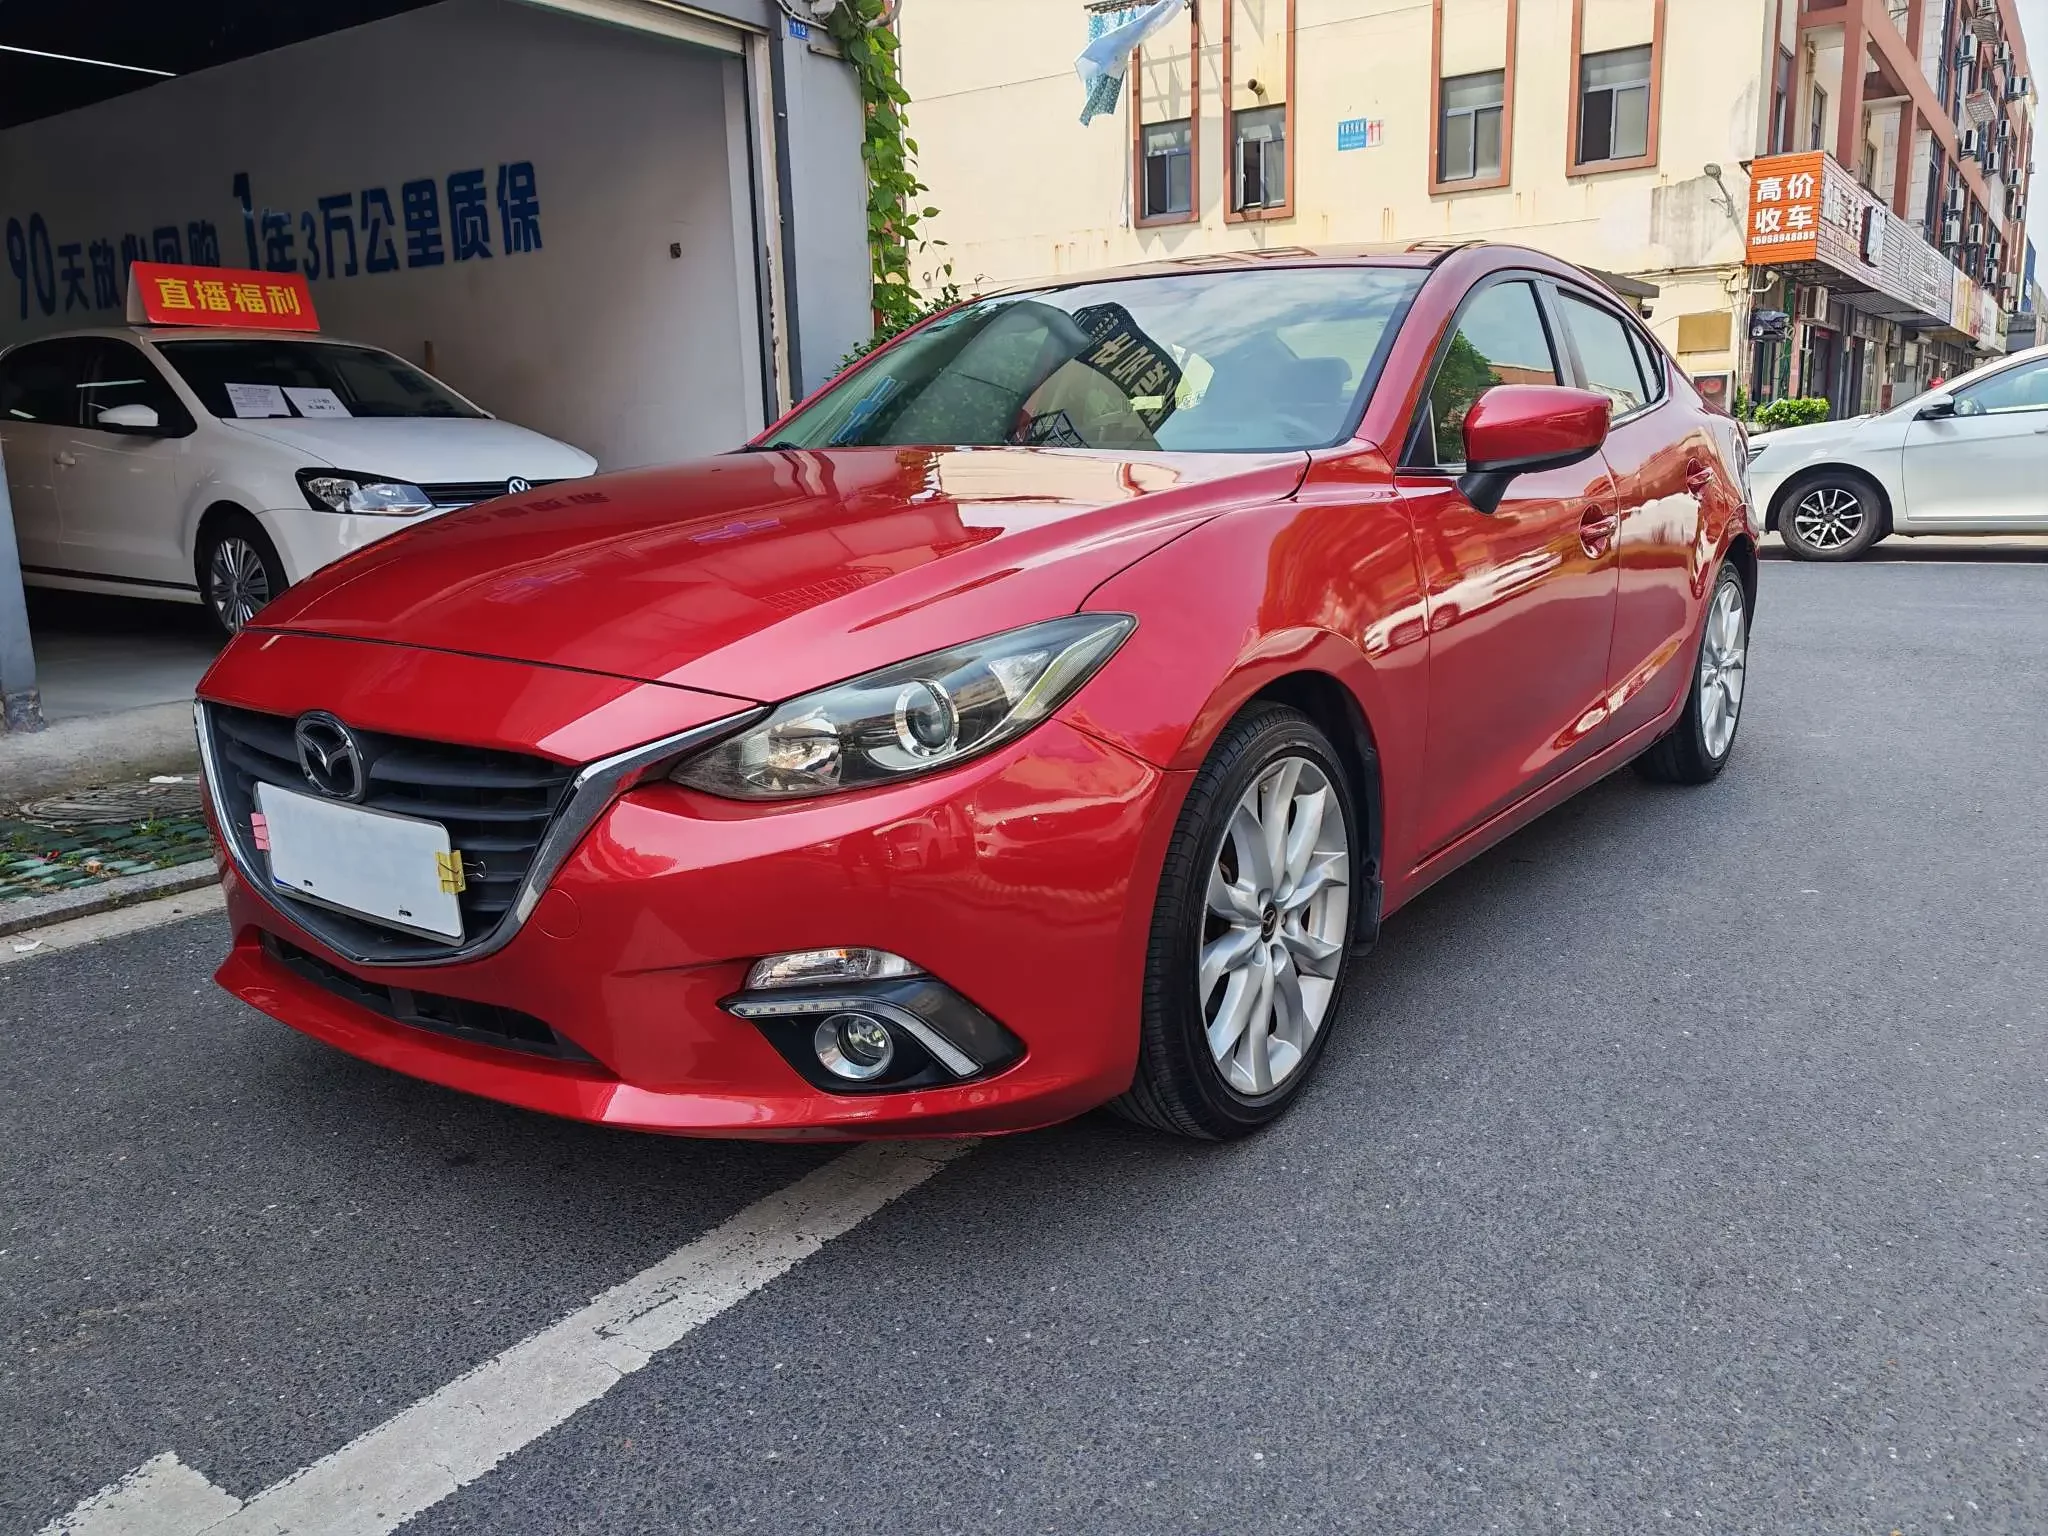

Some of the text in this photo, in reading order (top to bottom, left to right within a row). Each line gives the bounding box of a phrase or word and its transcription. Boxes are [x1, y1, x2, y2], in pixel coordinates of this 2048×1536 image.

[1757, 173, 1814, 202] 高价
[1755, 205, 1813, 234] 收车
[155, 278, 300, 315] 直播福利
